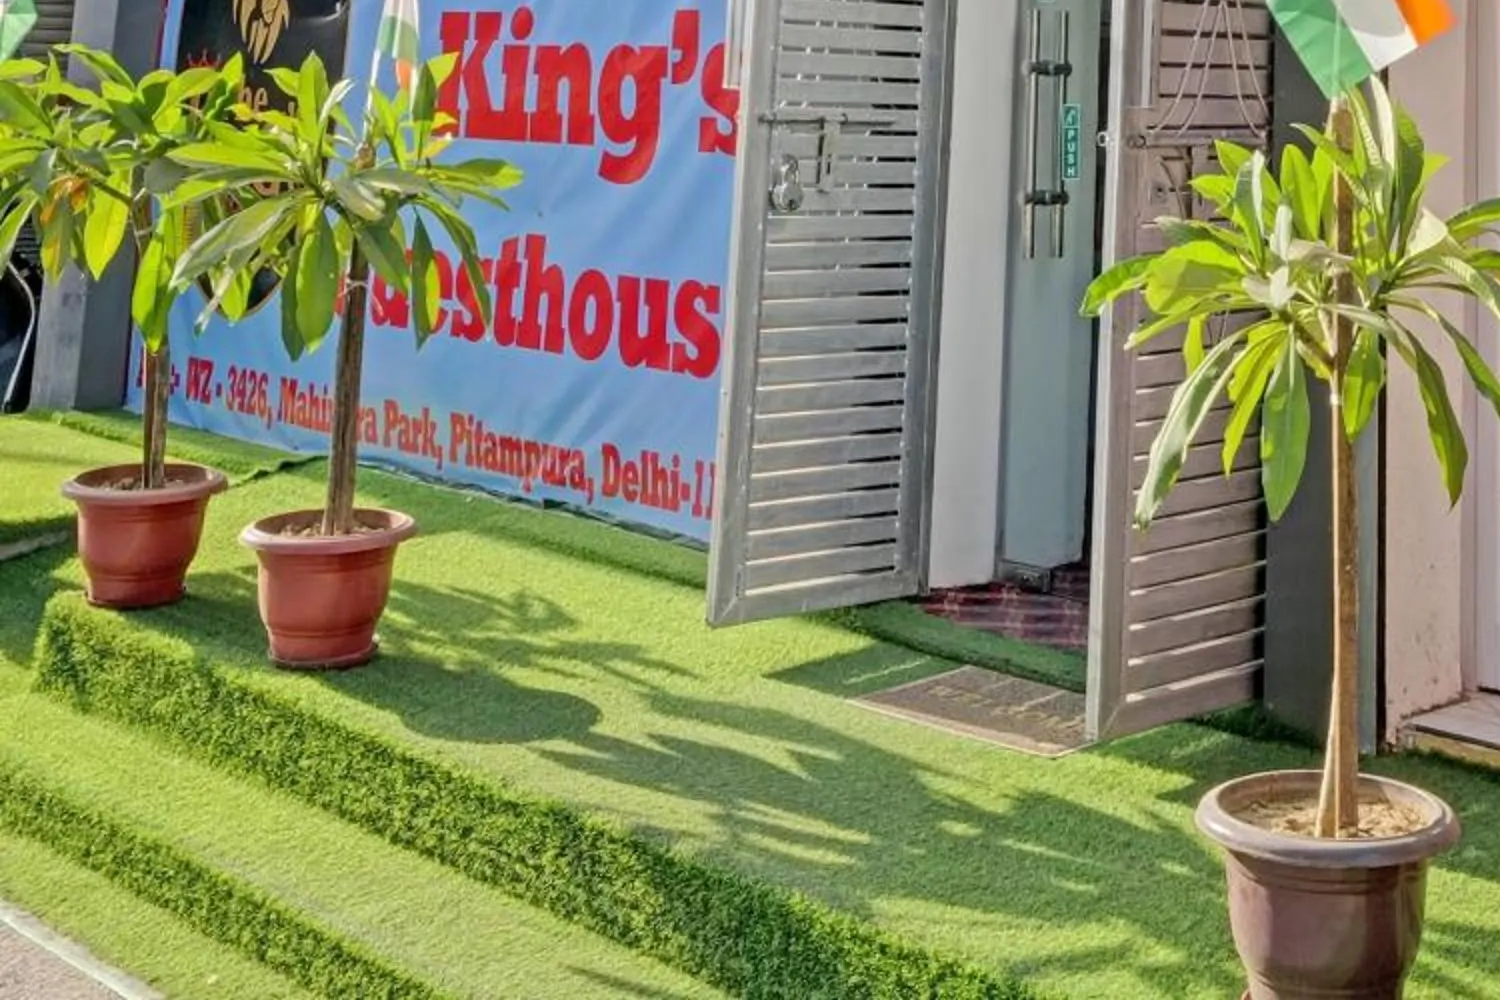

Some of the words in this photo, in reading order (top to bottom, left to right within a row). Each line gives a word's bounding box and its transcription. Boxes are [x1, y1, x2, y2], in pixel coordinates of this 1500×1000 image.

[226, 365, 274, 431] 3426,
[383, 398, 443, 470] Park,
[449, 411, 595, 504] Pitampura,
